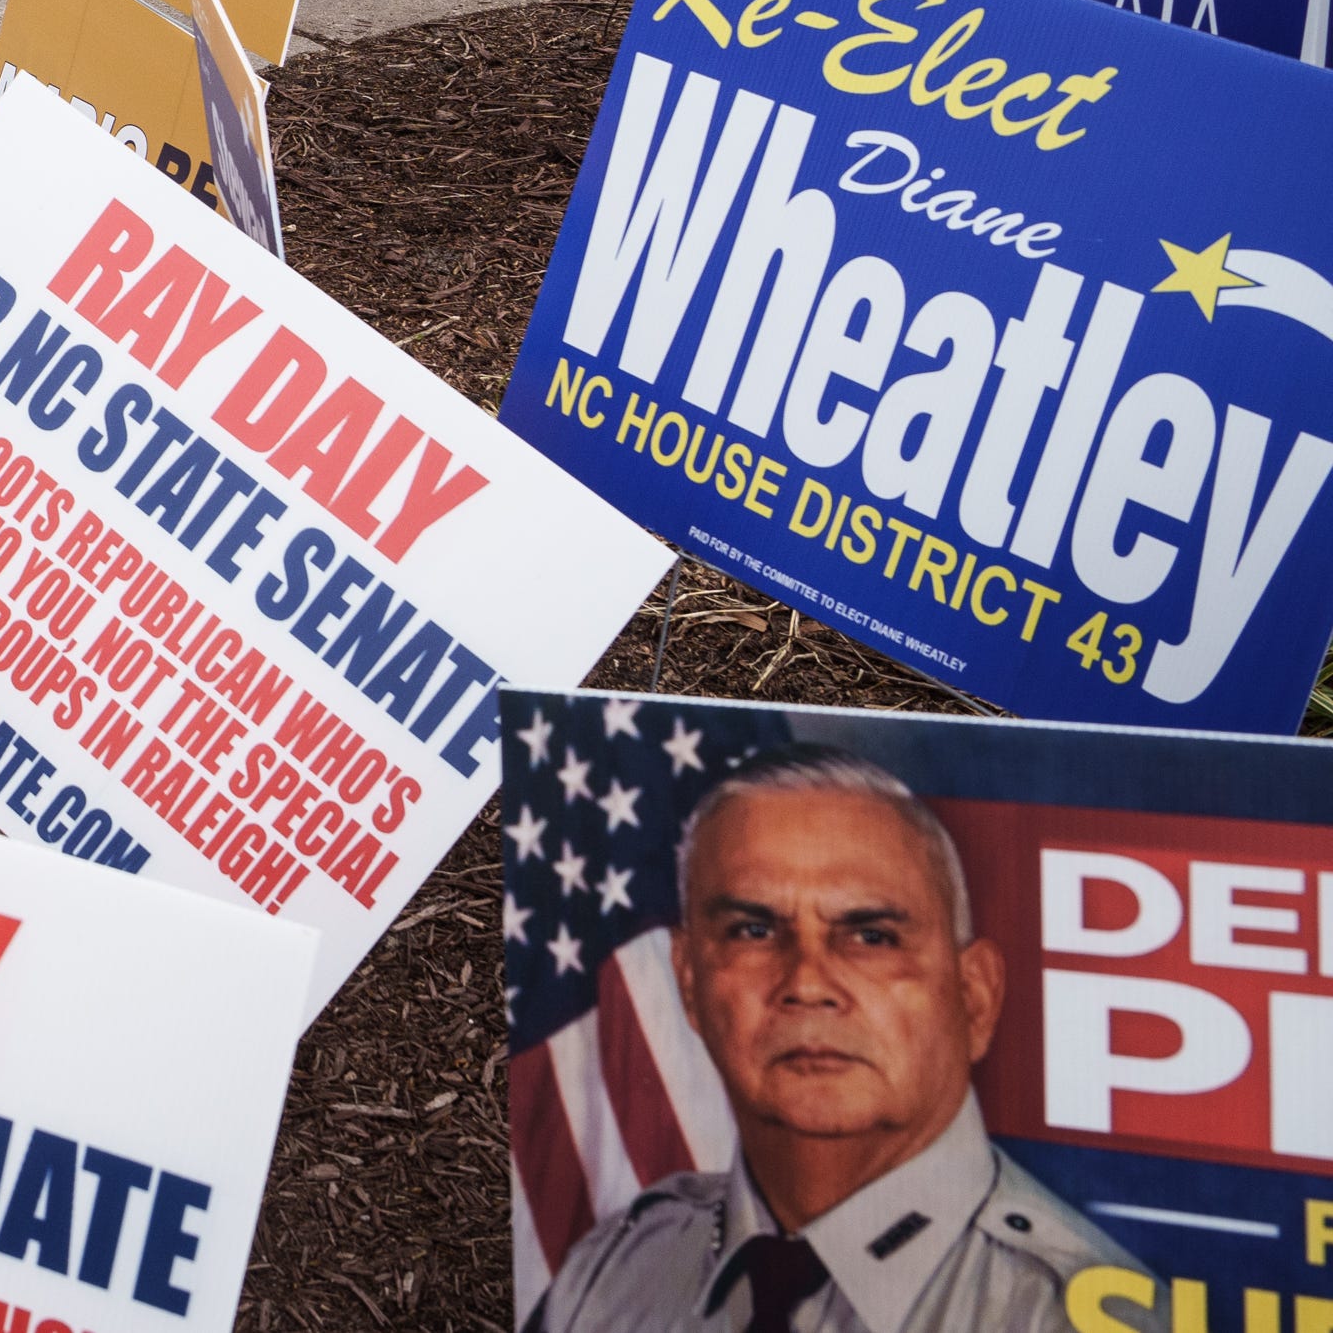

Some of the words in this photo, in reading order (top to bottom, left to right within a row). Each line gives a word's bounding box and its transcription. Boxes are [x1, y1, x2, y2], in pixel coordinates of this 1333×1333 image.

[838, 130, 1064, 259] Diane
[46, 197, 263, 391] RAY
[211, 325, 491, 565] DALY
[545, 356, 615, 430] NC
[618, 399, 789, 520] HOUSE
[790, 480, 1062, 644] DISTRICT
[1066, 611, 1143, 685] 43
[562, 52, 1333, 705] Wheatley
[8, 540, 98, 653] YOU,
[88, 617, 177, 711] NOT
[156, 679, 250, 765] THE
[229, 741, 401, 910] SPECIAL
[57, 510, 293, 727] REPUBLICAN
[274, 689, 422, 836] WHO'S
[77, 382, 288, 584] STATE
[255, 527, 499, 778] SENATE
[688, 526, 710, 544] PAID
[709, 537, 730, 555] FOR
[728, 547, 744, 562] BY
[743, 554, 763, 573] THE
[762, 565, 820, 602] COMMITTEE
[820, 593, 835, 610] TO
[834, 602, 871, 626] ELECT
[869, 619, 904, 644] DIANE
[905, 635, 967, 672] WHEATLEY
[78, 709, 145, 771] IN
[120, 736, 312, 917] RALEIGH!
[1041, 847, 1333, 978] DE
